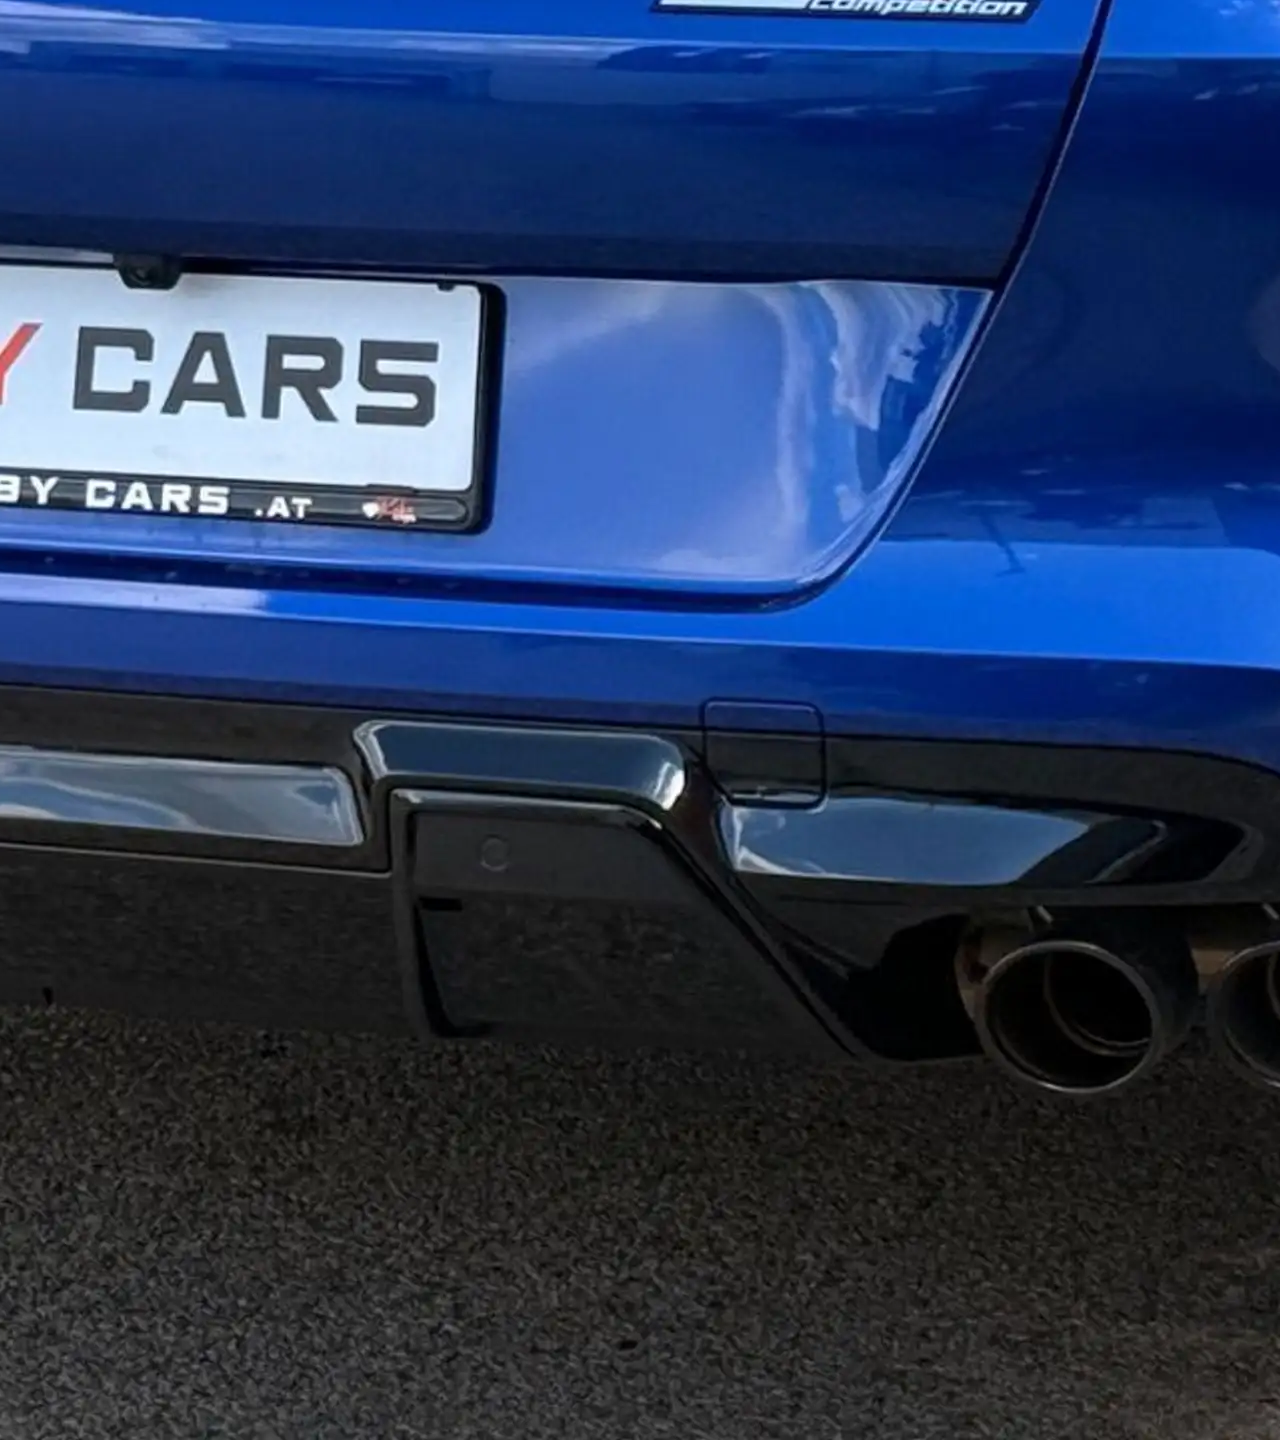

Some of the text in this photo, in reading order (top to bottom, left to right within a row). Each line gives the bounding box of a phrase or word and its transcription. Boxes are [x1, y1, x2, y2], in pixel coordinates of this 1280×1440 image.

[72, 325, 441, 427] CARS
[85, 481, 230, 516] CARS
[254, 496, 313, 520] .AT
